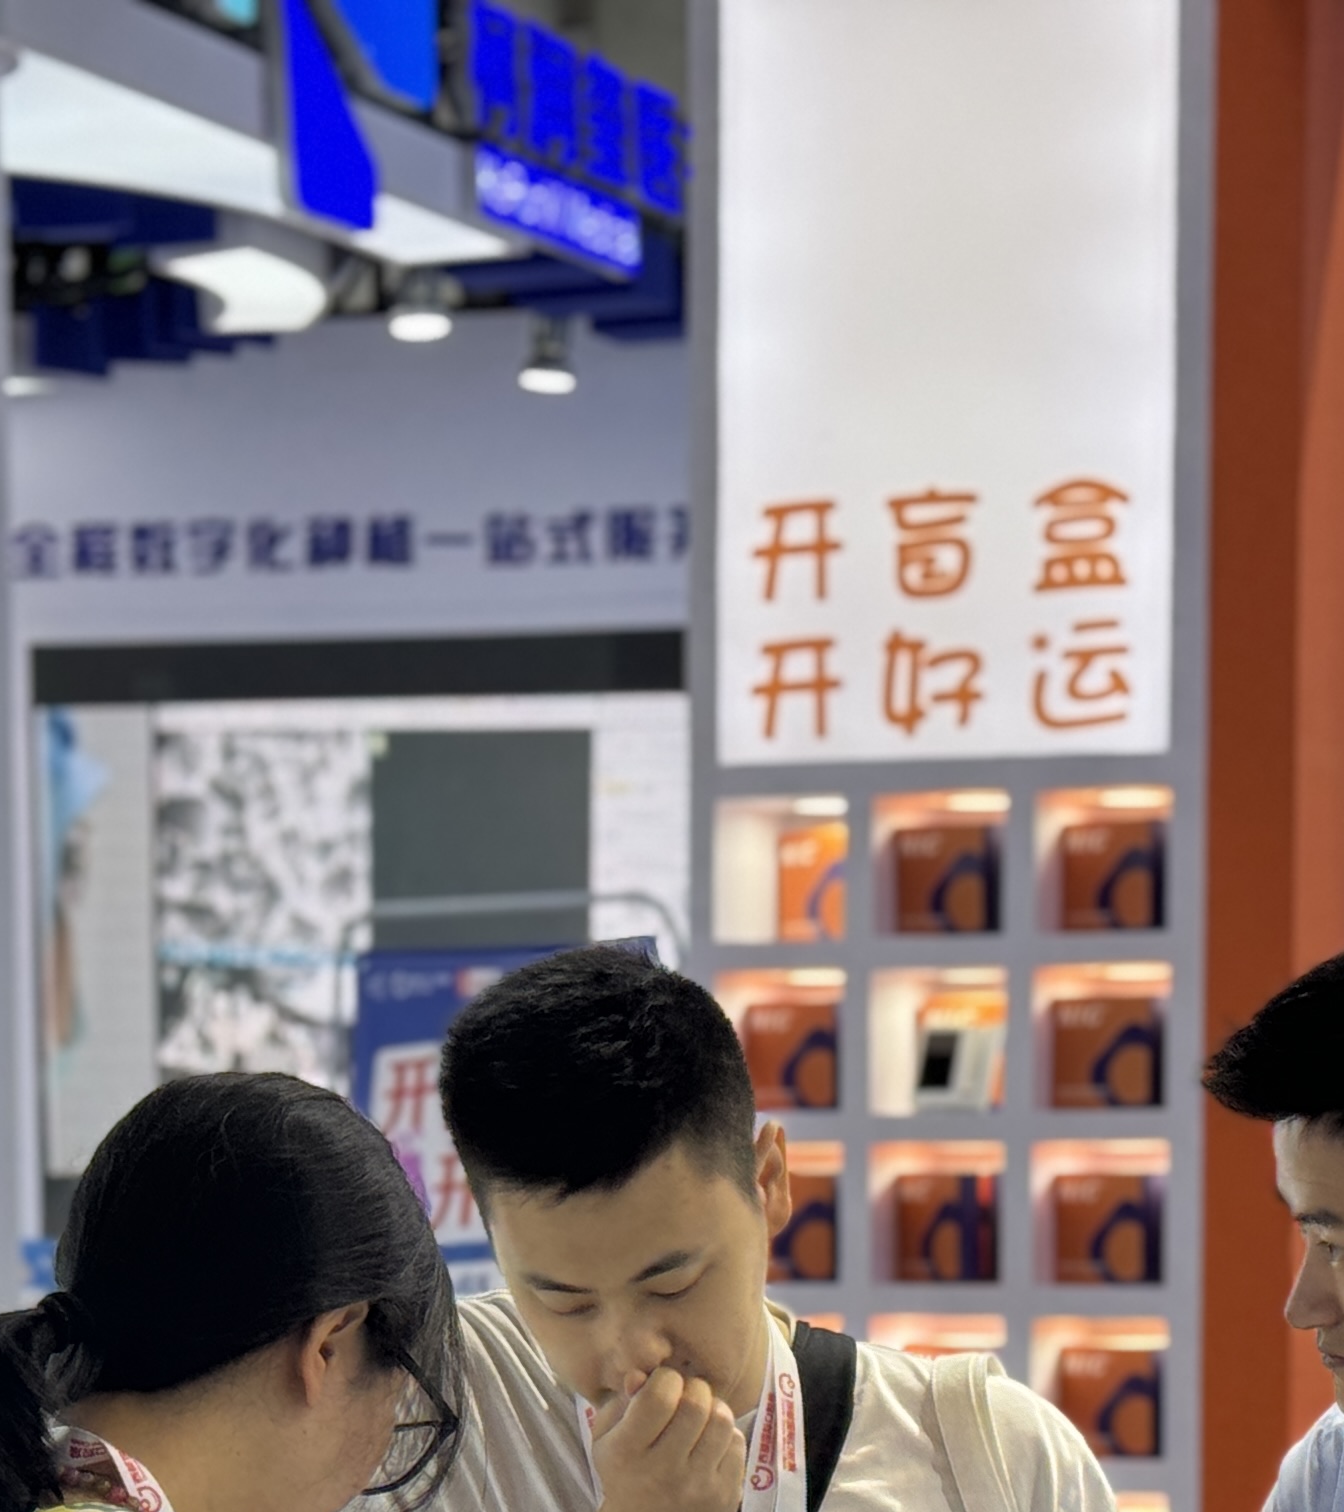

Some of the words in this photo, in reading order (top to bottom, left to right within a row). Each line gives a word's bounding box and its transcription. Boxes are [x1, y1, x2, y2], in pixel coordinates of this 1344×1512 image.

[752, 480, 1130, 602] 开盲盒
[750, 620, 1130, 741] 开好运
